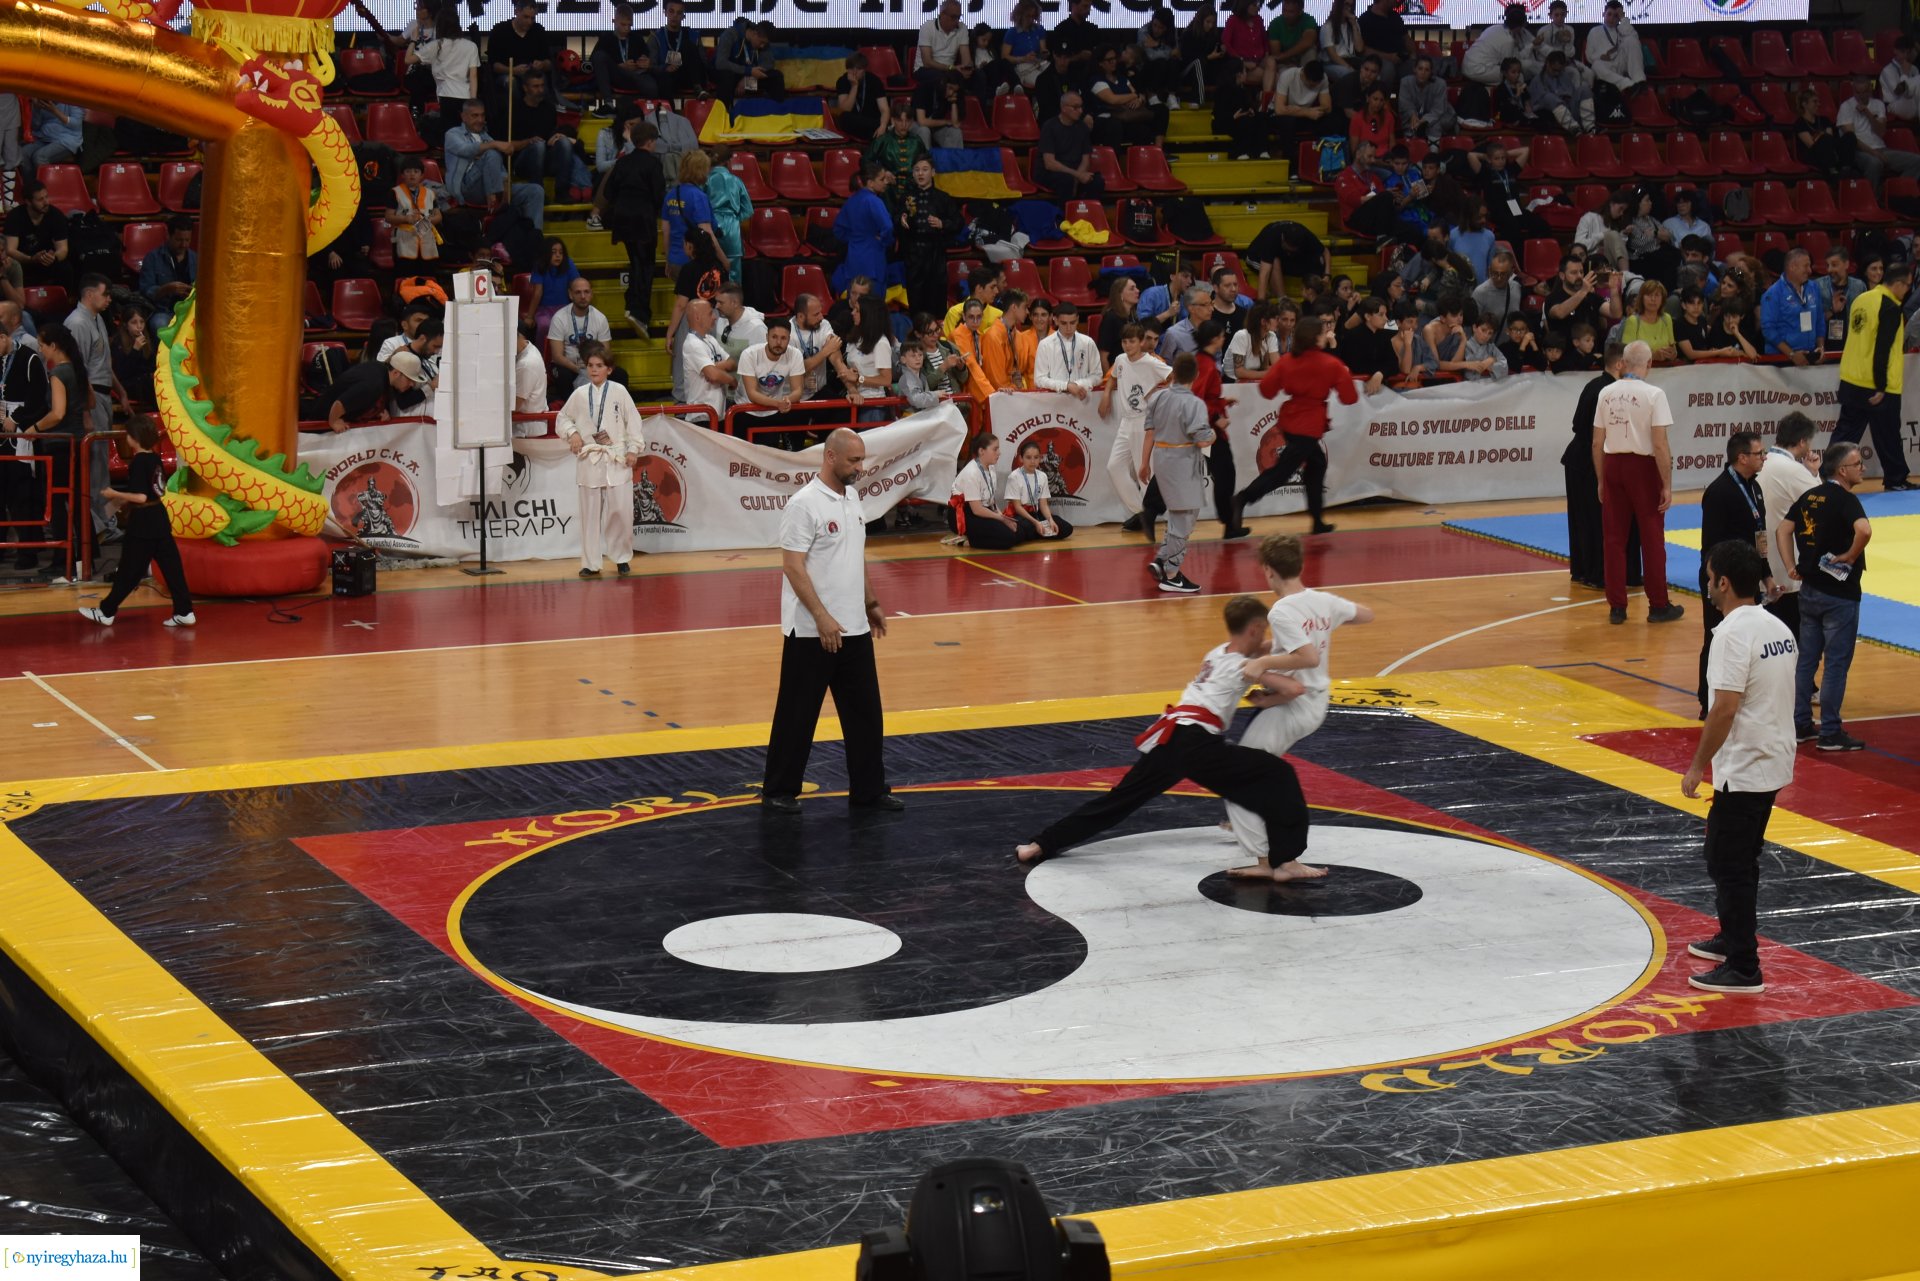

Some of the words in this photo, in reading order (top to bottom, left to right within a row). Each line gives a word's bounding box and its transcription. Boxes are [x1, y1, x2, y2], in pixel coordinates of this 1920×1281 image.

[475, 275, 487, 296] C
[1688, 392, 1715, 407] PER
[1717, 392, 1736, 406] LO
[1739, 390, 1812, 406] SVILUPPO
[1005, 413, 1052, 444] WORLD
[1250, 410, 1279, 437] WORL
[1369, 422, 1398, 437] PER
[1401, 420, 1420, 436] LO
[1423, 417, 1491, 435] SVILUPPO
[1495, 415, 1536, 431] DELLE
[1694, 423, 1726, 438] ARTI
[325, 448, 377, 481] WORLD
[1369, 451, 1434, 468] CULTURE
[1437, 450, 1466, 465] TRA
[1469, 450, 1475, 464] I
[1477, 447, 1533, 464] POPOLI
[1676, 454, 1724, 470] SPORT
[729, 462, 762, 478] PER
[766, 471, 791, 483] LO
[469, 499, 508, 521] TAI
[513, 498, 557, 517] CHI
[456, 515, 573, 539] THERAPY
